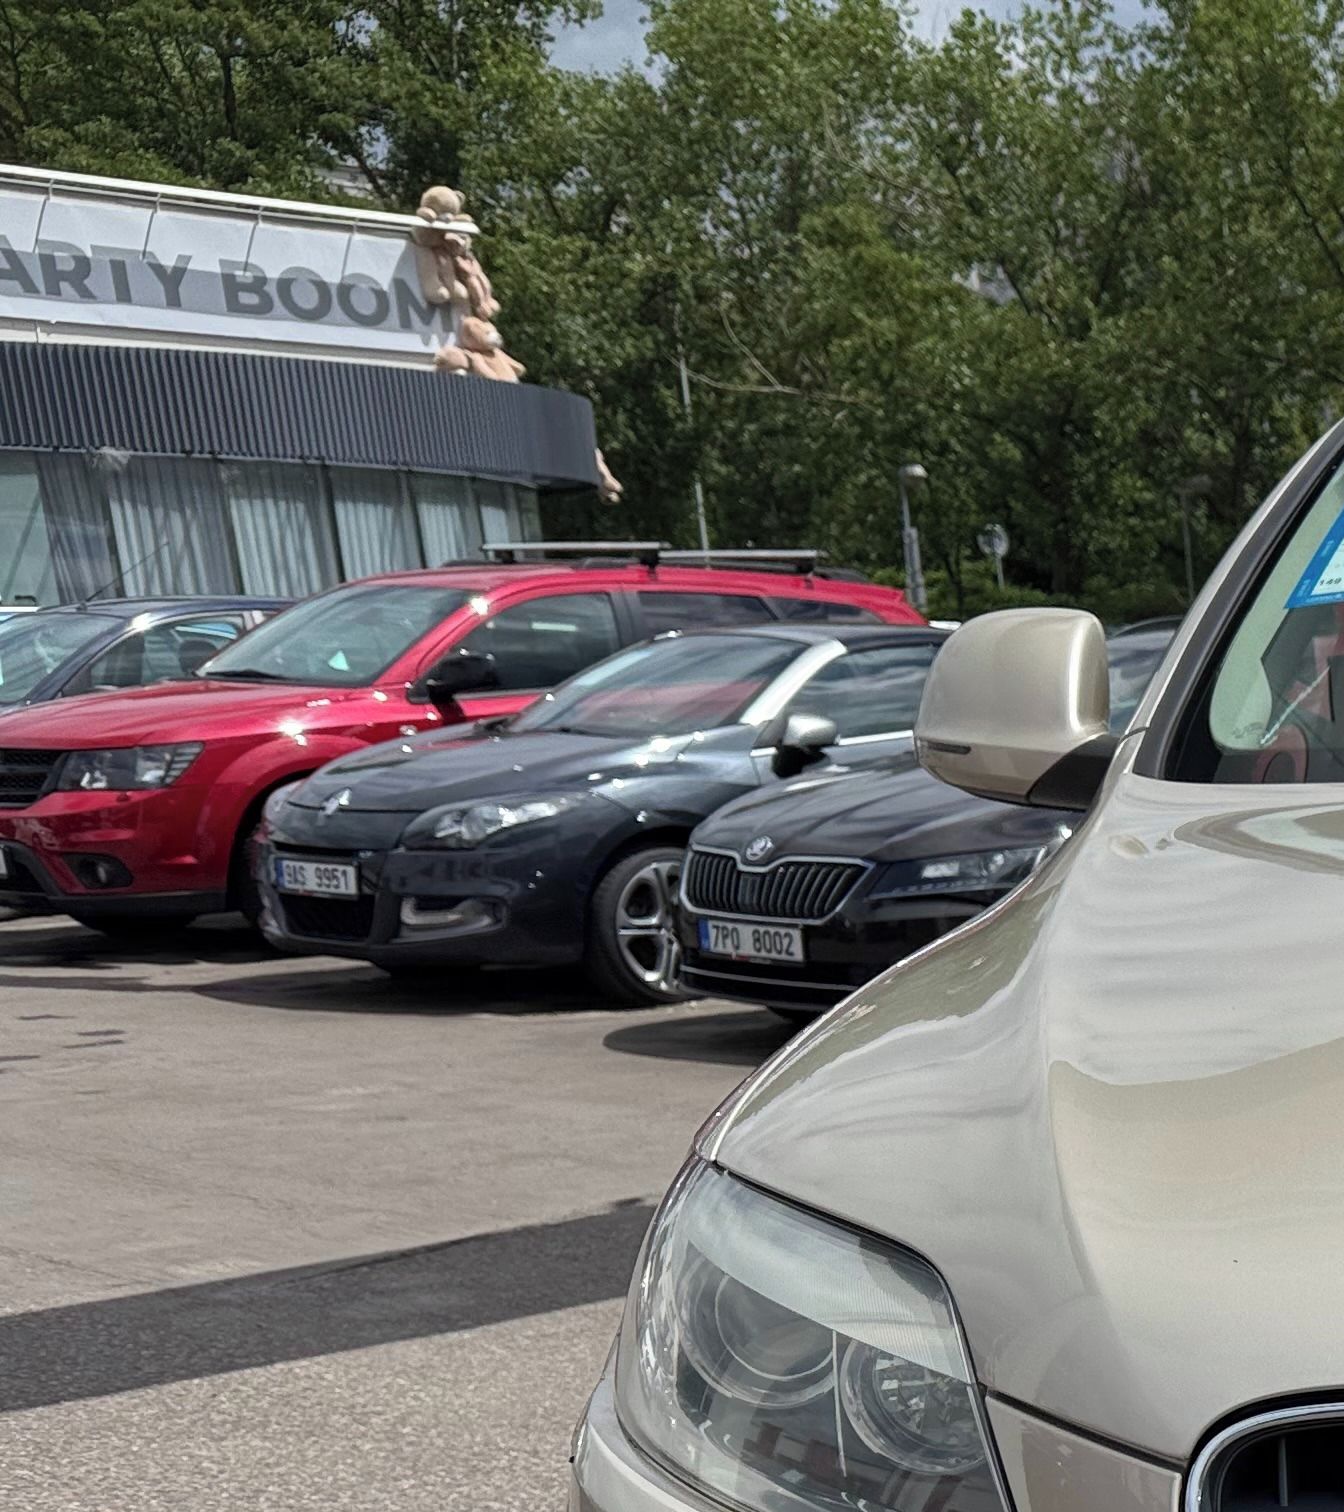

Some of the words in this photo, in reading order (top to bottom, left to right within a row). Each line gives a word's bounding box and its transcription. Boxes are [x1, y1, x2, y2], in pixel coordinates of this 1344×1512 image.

[218, 257, 454, 332] BOOM
[314, 866, 349, 891] 9951
[751, 928, 796, 957] 8002
